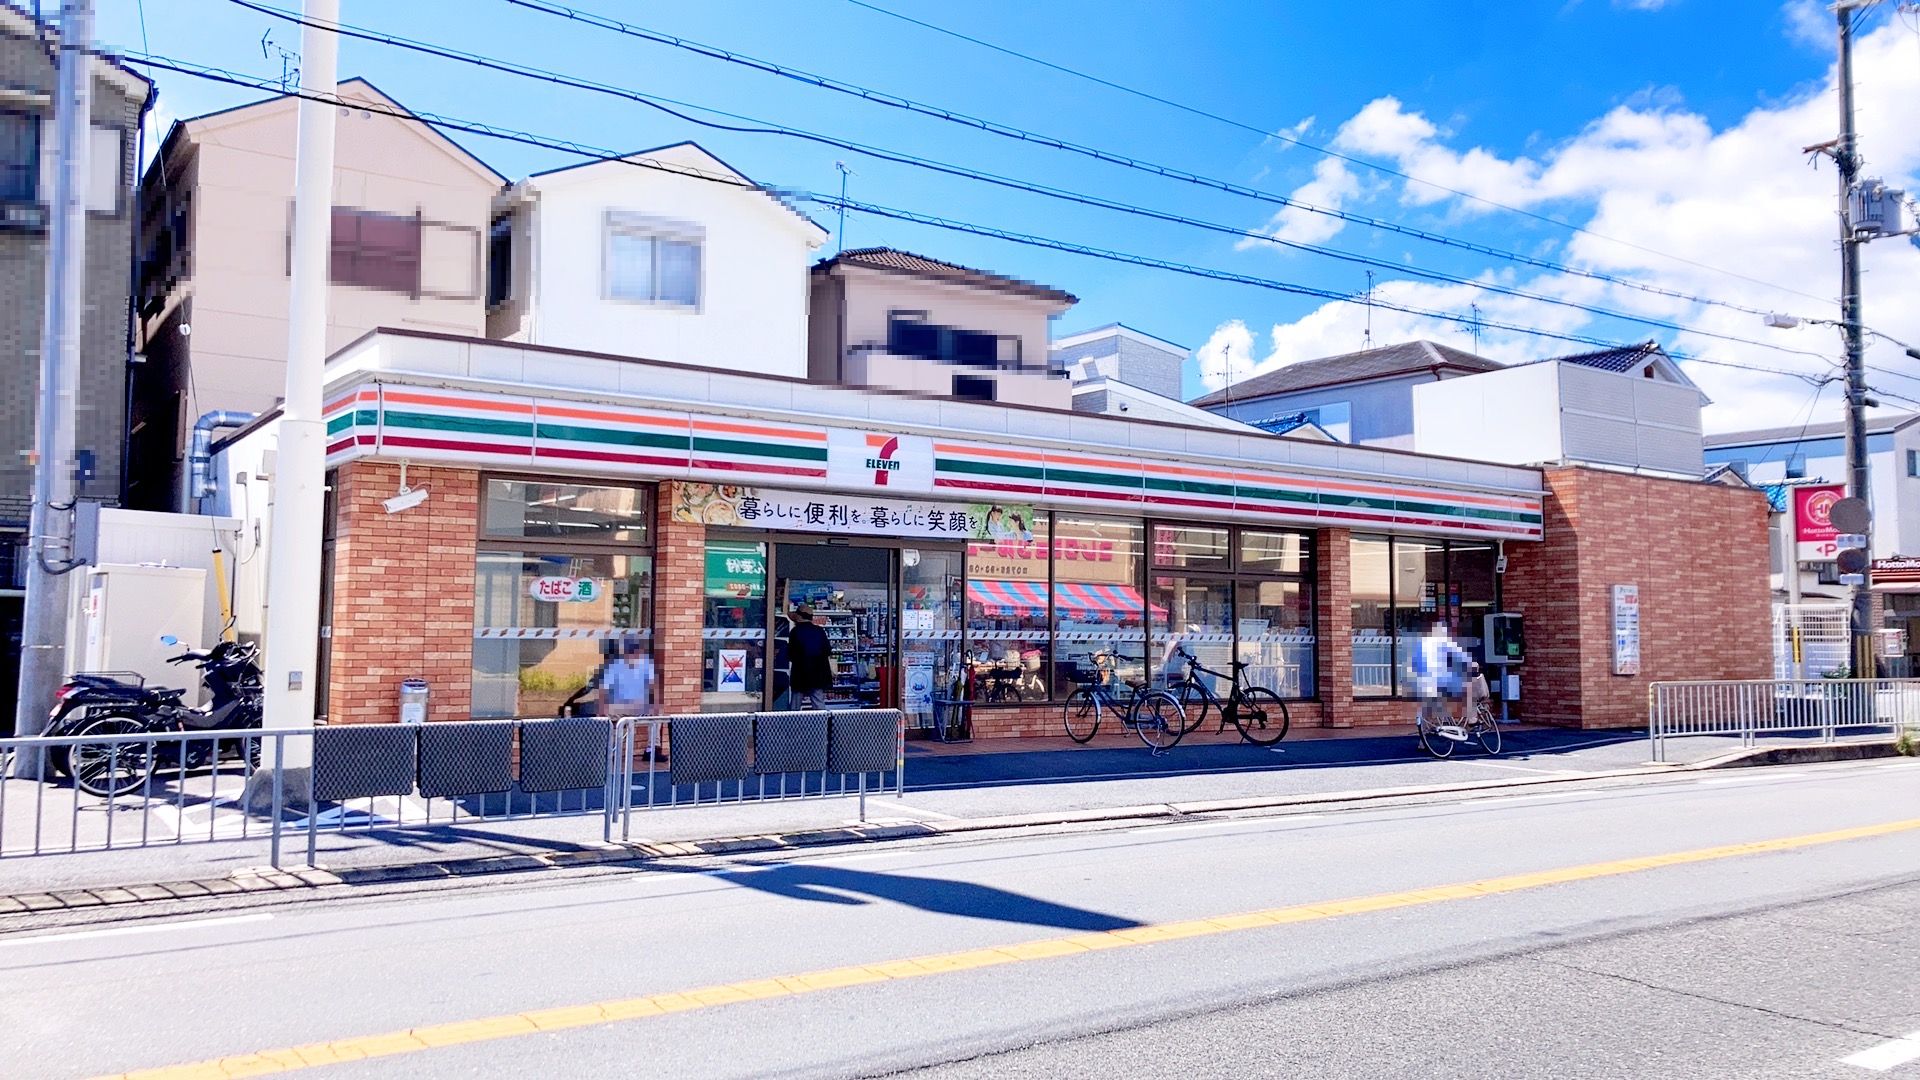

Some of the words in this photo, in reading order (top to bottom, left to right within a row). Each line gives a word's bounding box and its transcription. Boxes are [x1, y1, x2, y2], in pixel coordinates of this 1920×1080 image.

[866, 434, 898, 485] 7
[1824, 543, 1838, 557] P
[540, 580, 572, 595] たばこ
[578, 581, 592, 595] 酒
